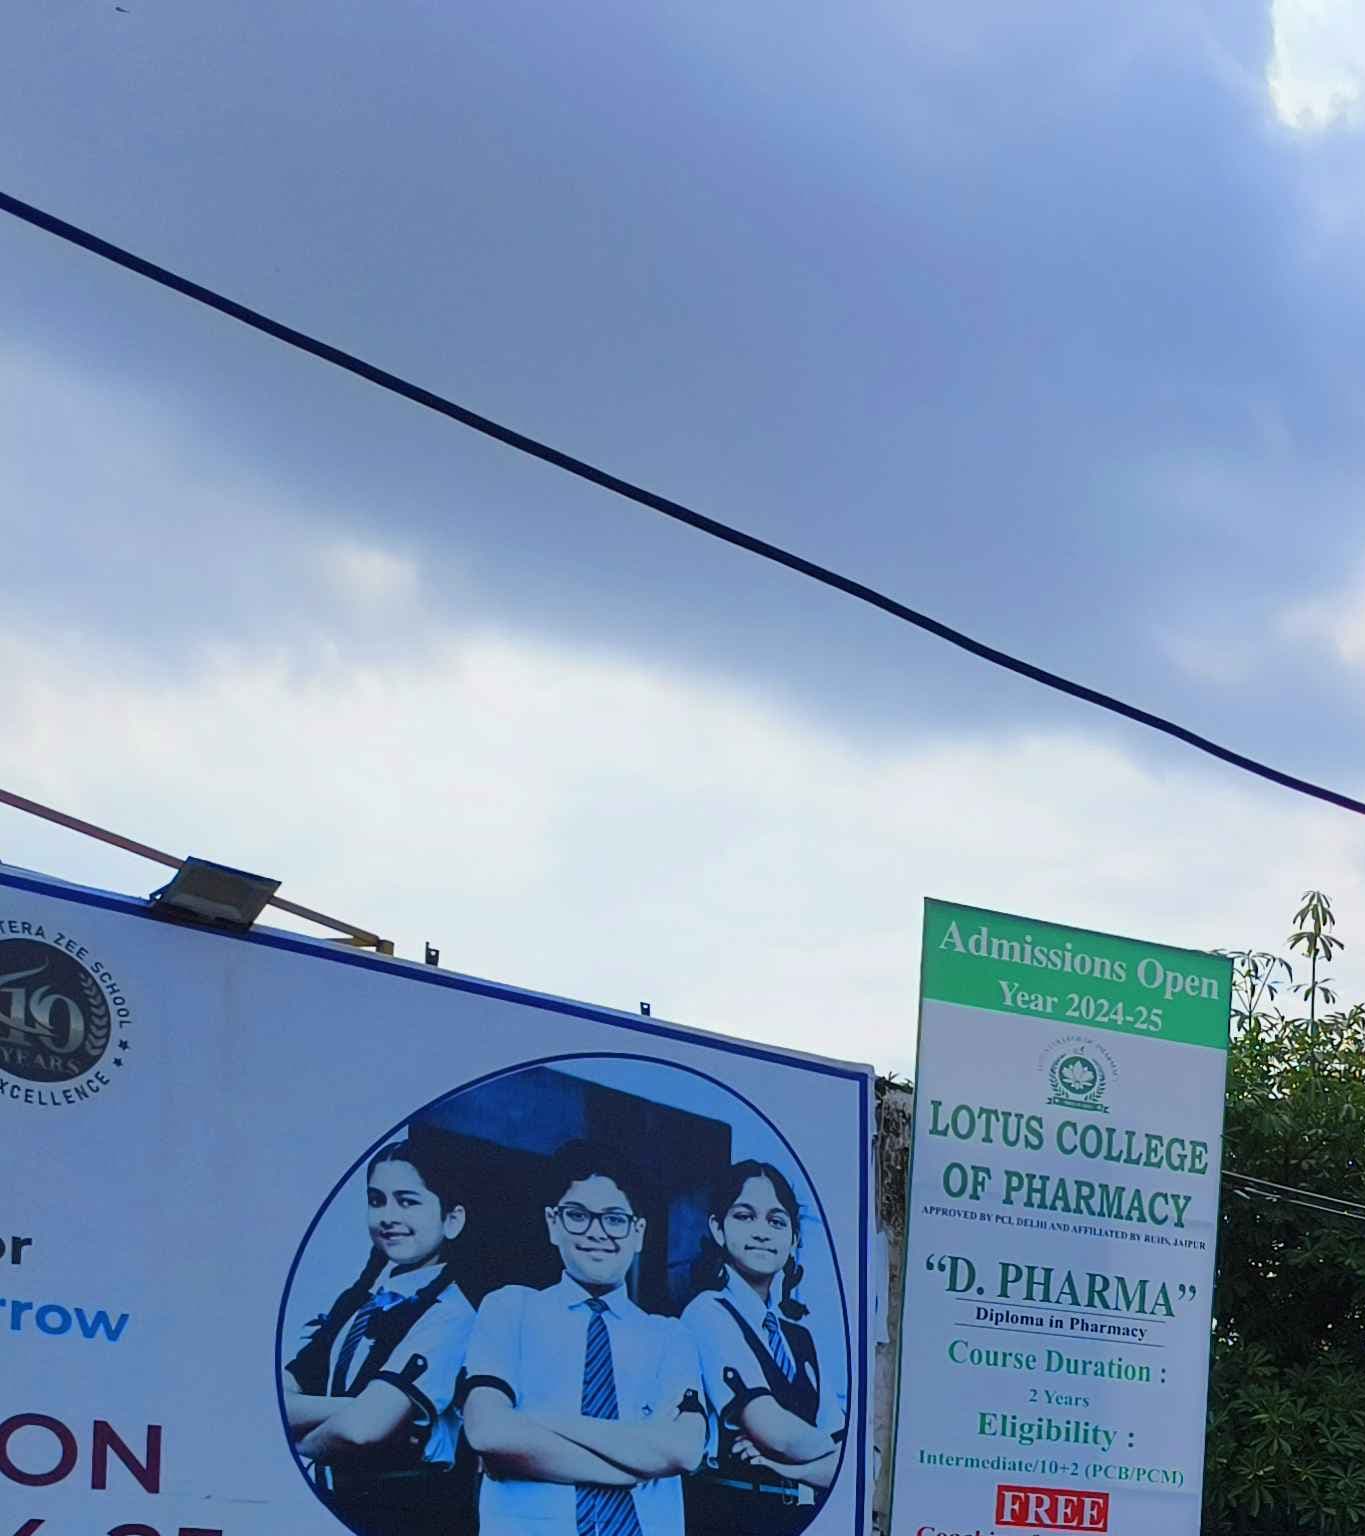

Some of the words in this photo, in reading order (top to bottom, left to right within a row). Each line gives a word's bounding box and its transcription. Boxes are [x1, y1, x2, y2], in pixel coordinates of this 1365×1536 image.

[53, 932, 89, 961] ZEE
[89, 961, 134, 1029] SCHOOL
[939, 919, 1127, 982] Admissions
[1137, 957, 1220, 1000] Open
[998, 980, 1058, 1013] Year
[1065, 992, 1163, 1032] 2024-25
[929, 1100, 1044, 1151] LOTUS
[1056, 1120, 1209, 1175] COLLEGE
[943, 1162, 991, 1200] OF
[1002, 1169, 1192, 1229] PHARMACY
[921, 1205, 978, 1222] APPROVED
[979, 1213, 994, 1225] BY
[1050, 1221, 1070, 1233] AND
[1072, 1224, 1128, 1240] AFFILIATED
[1130, 1231, 1143, 1242] BY
[1173, 1236, 1206, 1251] JAIPUR
[0, 1298, 129, 1342] row
[975, 1306, 1044, 1329] Diploma
[1049, 1315, 1064, 1330] in
[1070, 1318, 1148, 1341] Pharmacy
[948, 1339, 1037, 1372] Course
[1046, 1349, 1151, 1383] Duration
[1029, 1389, 1038, 1403] 2
[1044, 1390, 1090, 1408] Years
[977, 1411, 1118, 1452] Eligibility
[1085, 1462, 1185, 1487] (PCB/PCM)
[1000, 1490, 1106, 1529] FREE
